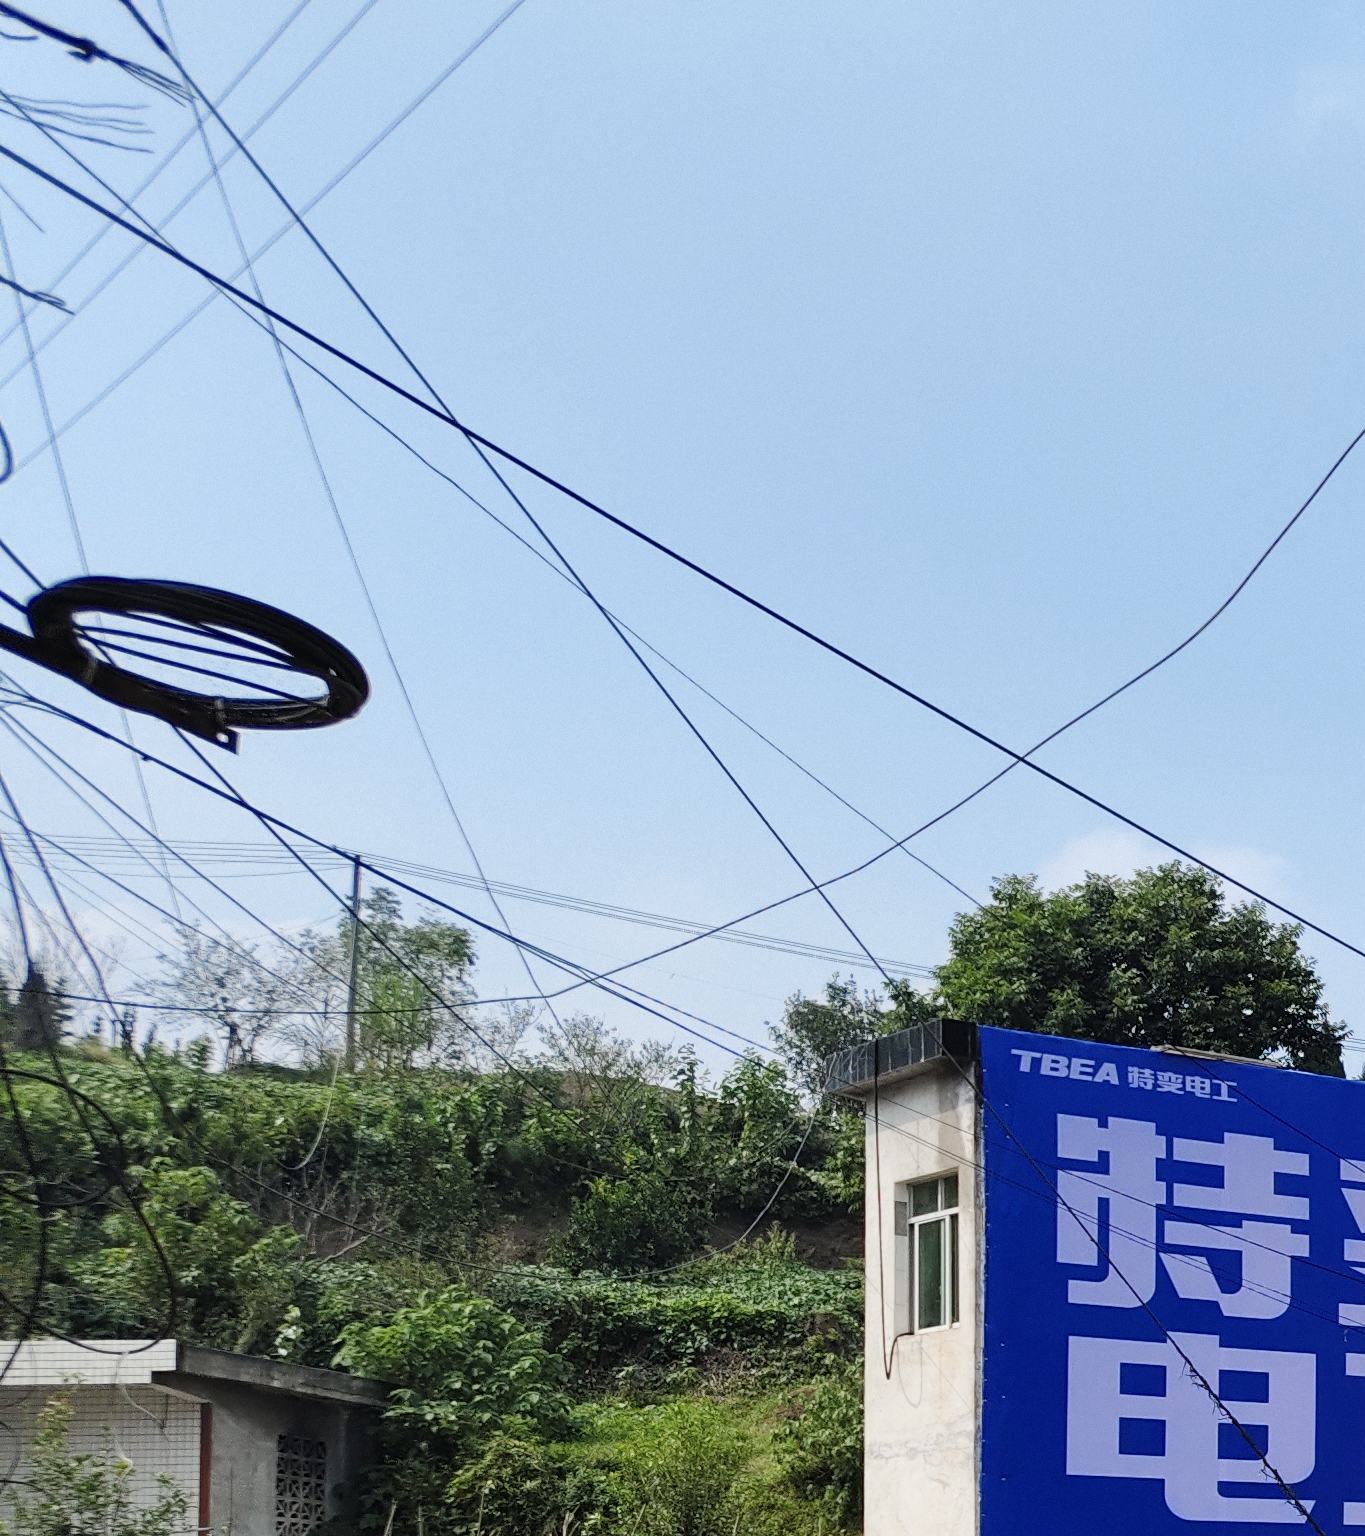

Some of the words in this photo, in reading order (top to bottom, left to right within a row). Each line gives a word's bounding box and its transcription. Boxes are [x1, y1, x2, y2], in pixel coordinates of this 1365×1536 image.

[1011, 1049, 1119, 1085] TBEA
[1128, 1066, 1237, 1102] 特变电工
